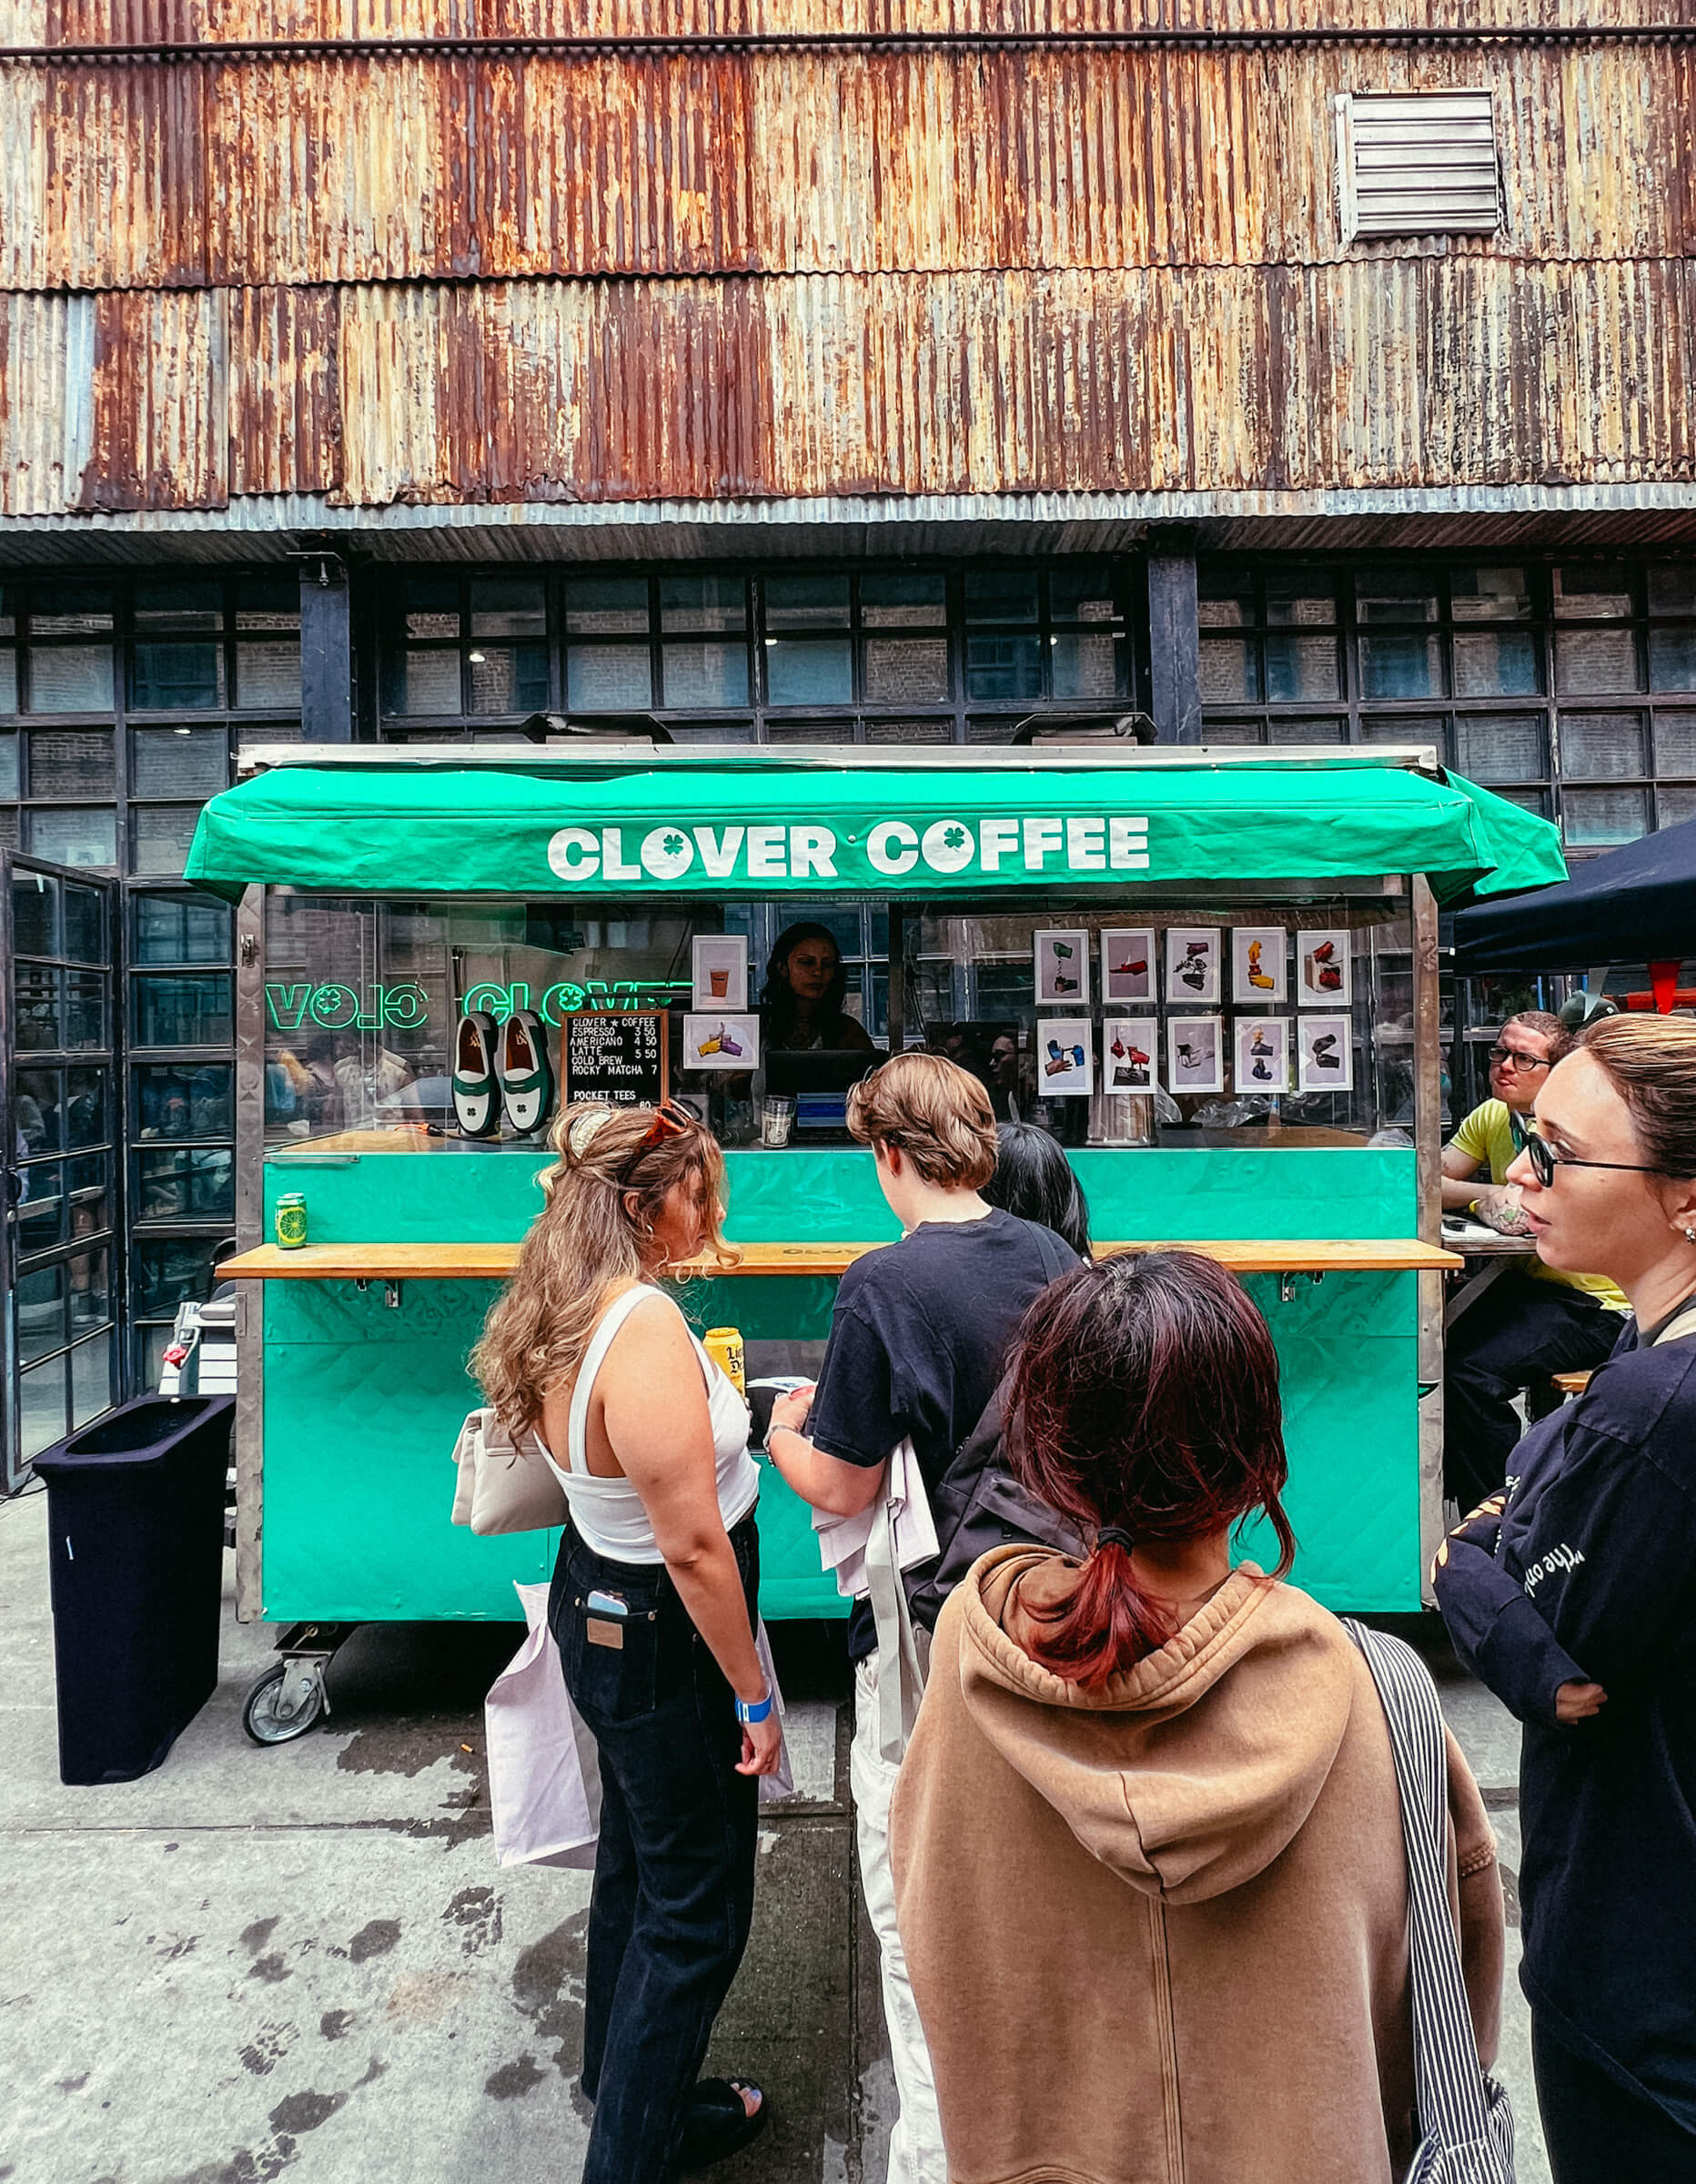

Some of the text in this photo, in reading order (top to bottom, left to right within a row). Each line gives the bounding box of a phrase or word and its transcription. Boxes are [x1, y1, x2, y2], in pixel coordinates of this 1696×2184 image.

[547, 816, 1150, 881] CLOVER COFFEE
[572, 1017, 656, 1027] CLOVER COFFEE
[572, 1026, 616, 1036] ESPRESSO
[643, 1026, 656, 1036] 50
[570, 1036, 657, 1046] AMERICANO 4 50
[571, 1046, 657, 1059] LATTE 5 50
[571, 1056, 623, 1066] COLD BREW
[572, 1065, 657, 1075] ROCKY MATCHA 7
[573, 1090, 636, 1100] POCKET TEES
